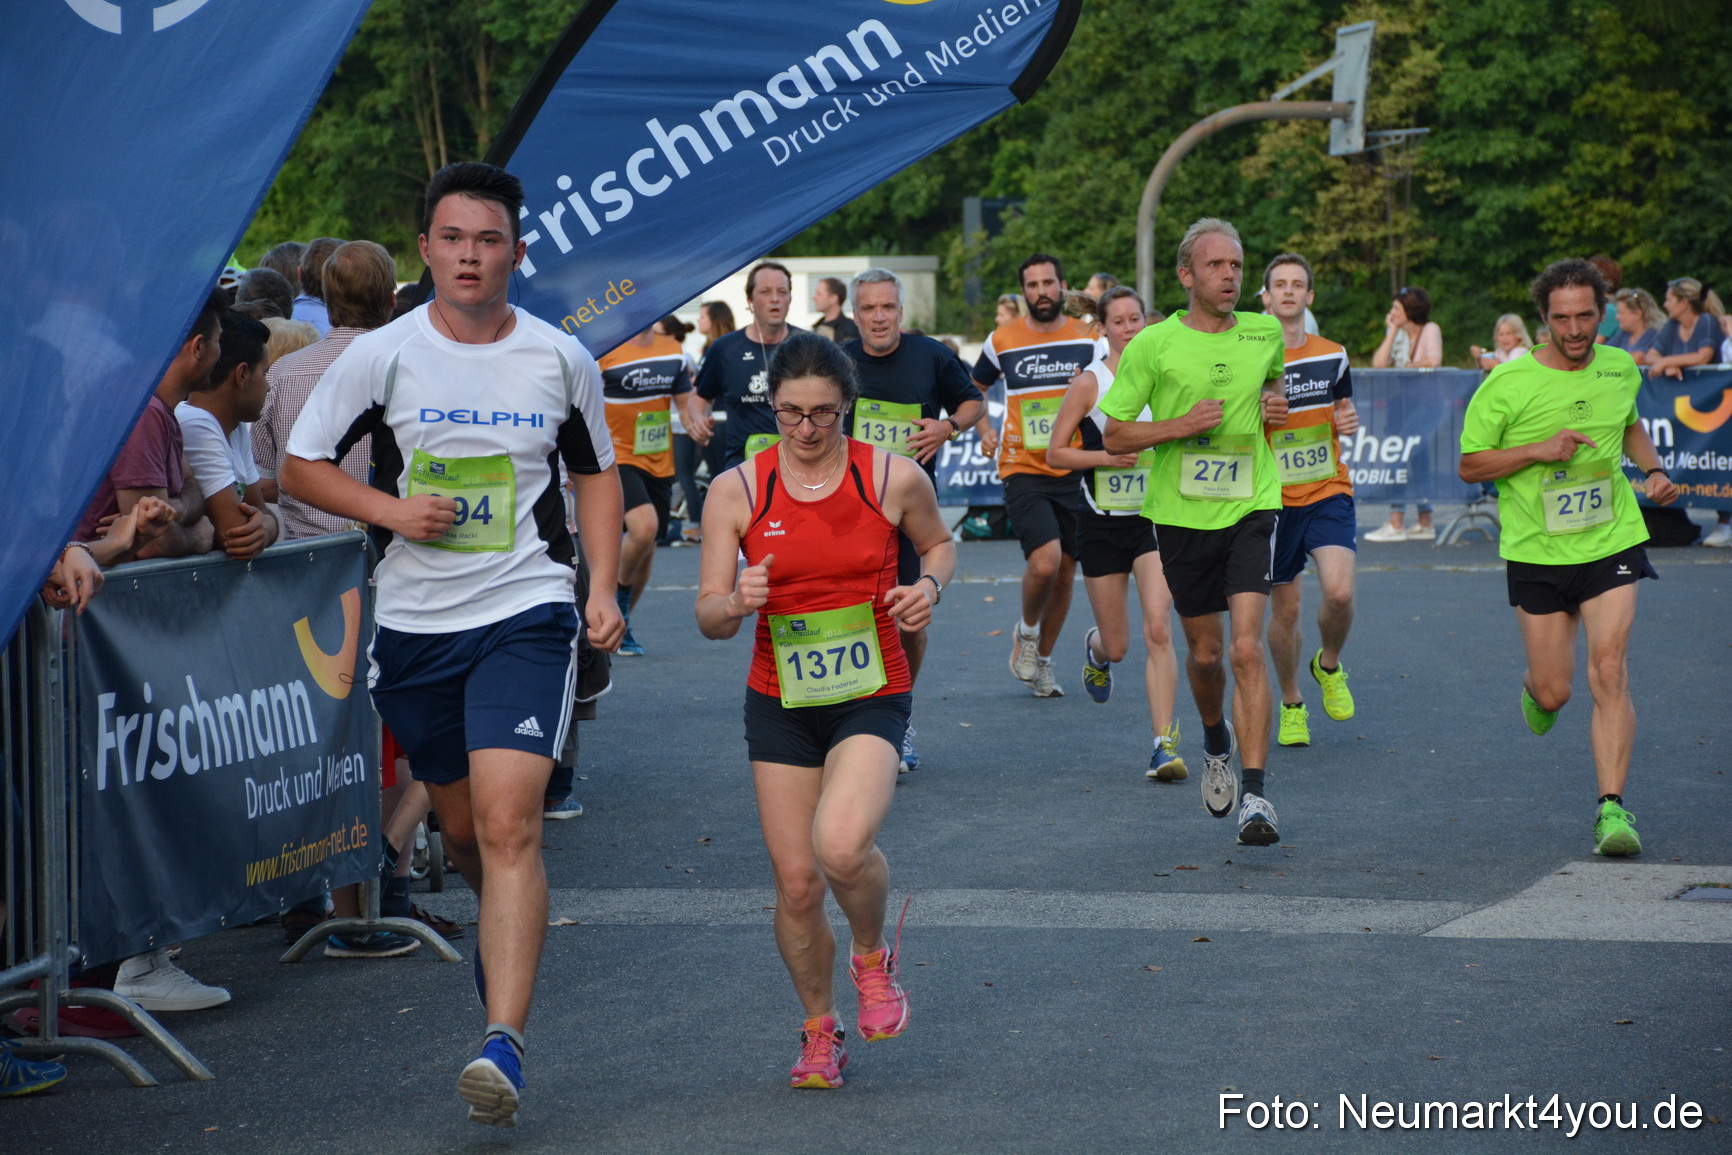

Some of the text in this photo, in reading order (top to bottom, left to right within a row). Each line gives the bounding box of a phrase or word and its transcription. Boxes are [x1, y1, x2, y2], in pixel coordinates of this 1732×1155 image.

[762, 97, 860, 166] Druck
[863, 61, 927, 106] und
[518, 19, 903, 279] Frischmann
[1026, 361, 1079, 375] Fischer
[632, 374, 674, 387] Fischer
[420, 408, 544, 428] DELPHI
[862, 422, 911, 443] 1311
[1280, 446, 1328, 470] 1639
[1194, 459, 1238, 482] 271
[1109, 474, 1144, 493] 971
[430, 493, 493, 527] 94
[1557, 487, 1602, 515] 275
[787, 641, 870, 681] 1370
[97, 674, 317, 791] Frischmann
[514, 727, 544, 738] adidas
[245, 766, 291, 819] Druck
[294, 756, 323, 806] und
